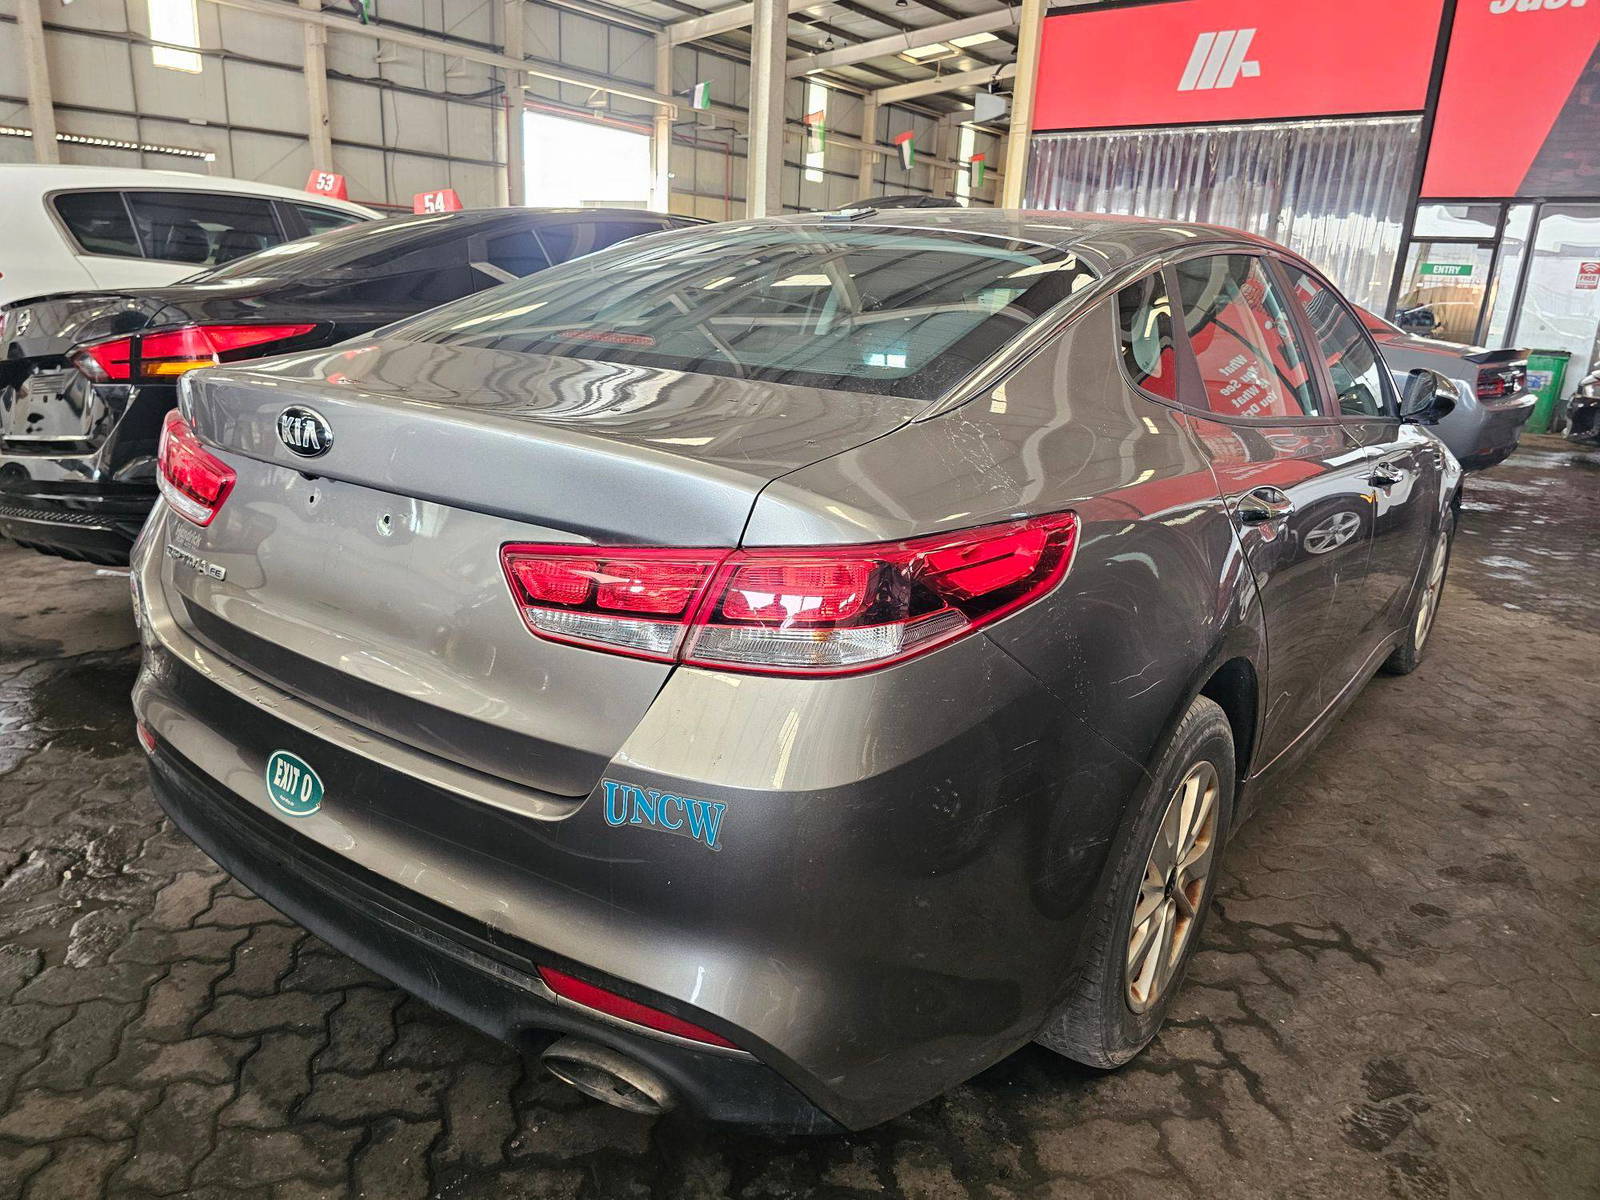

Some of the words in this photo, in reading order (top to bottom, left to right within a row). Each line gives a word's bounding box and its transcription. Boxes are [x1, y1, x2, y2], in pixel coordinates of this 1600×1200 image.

[316, 172, 335, 191] 53
[423, 191, 445, 213] 54
[1433, 265, 1462, 274] ENTRY
[281, 415, 320, 450] KIA
[273, 757, 300, 795] EXIT
[603, 781, 726, 847] UNCW
